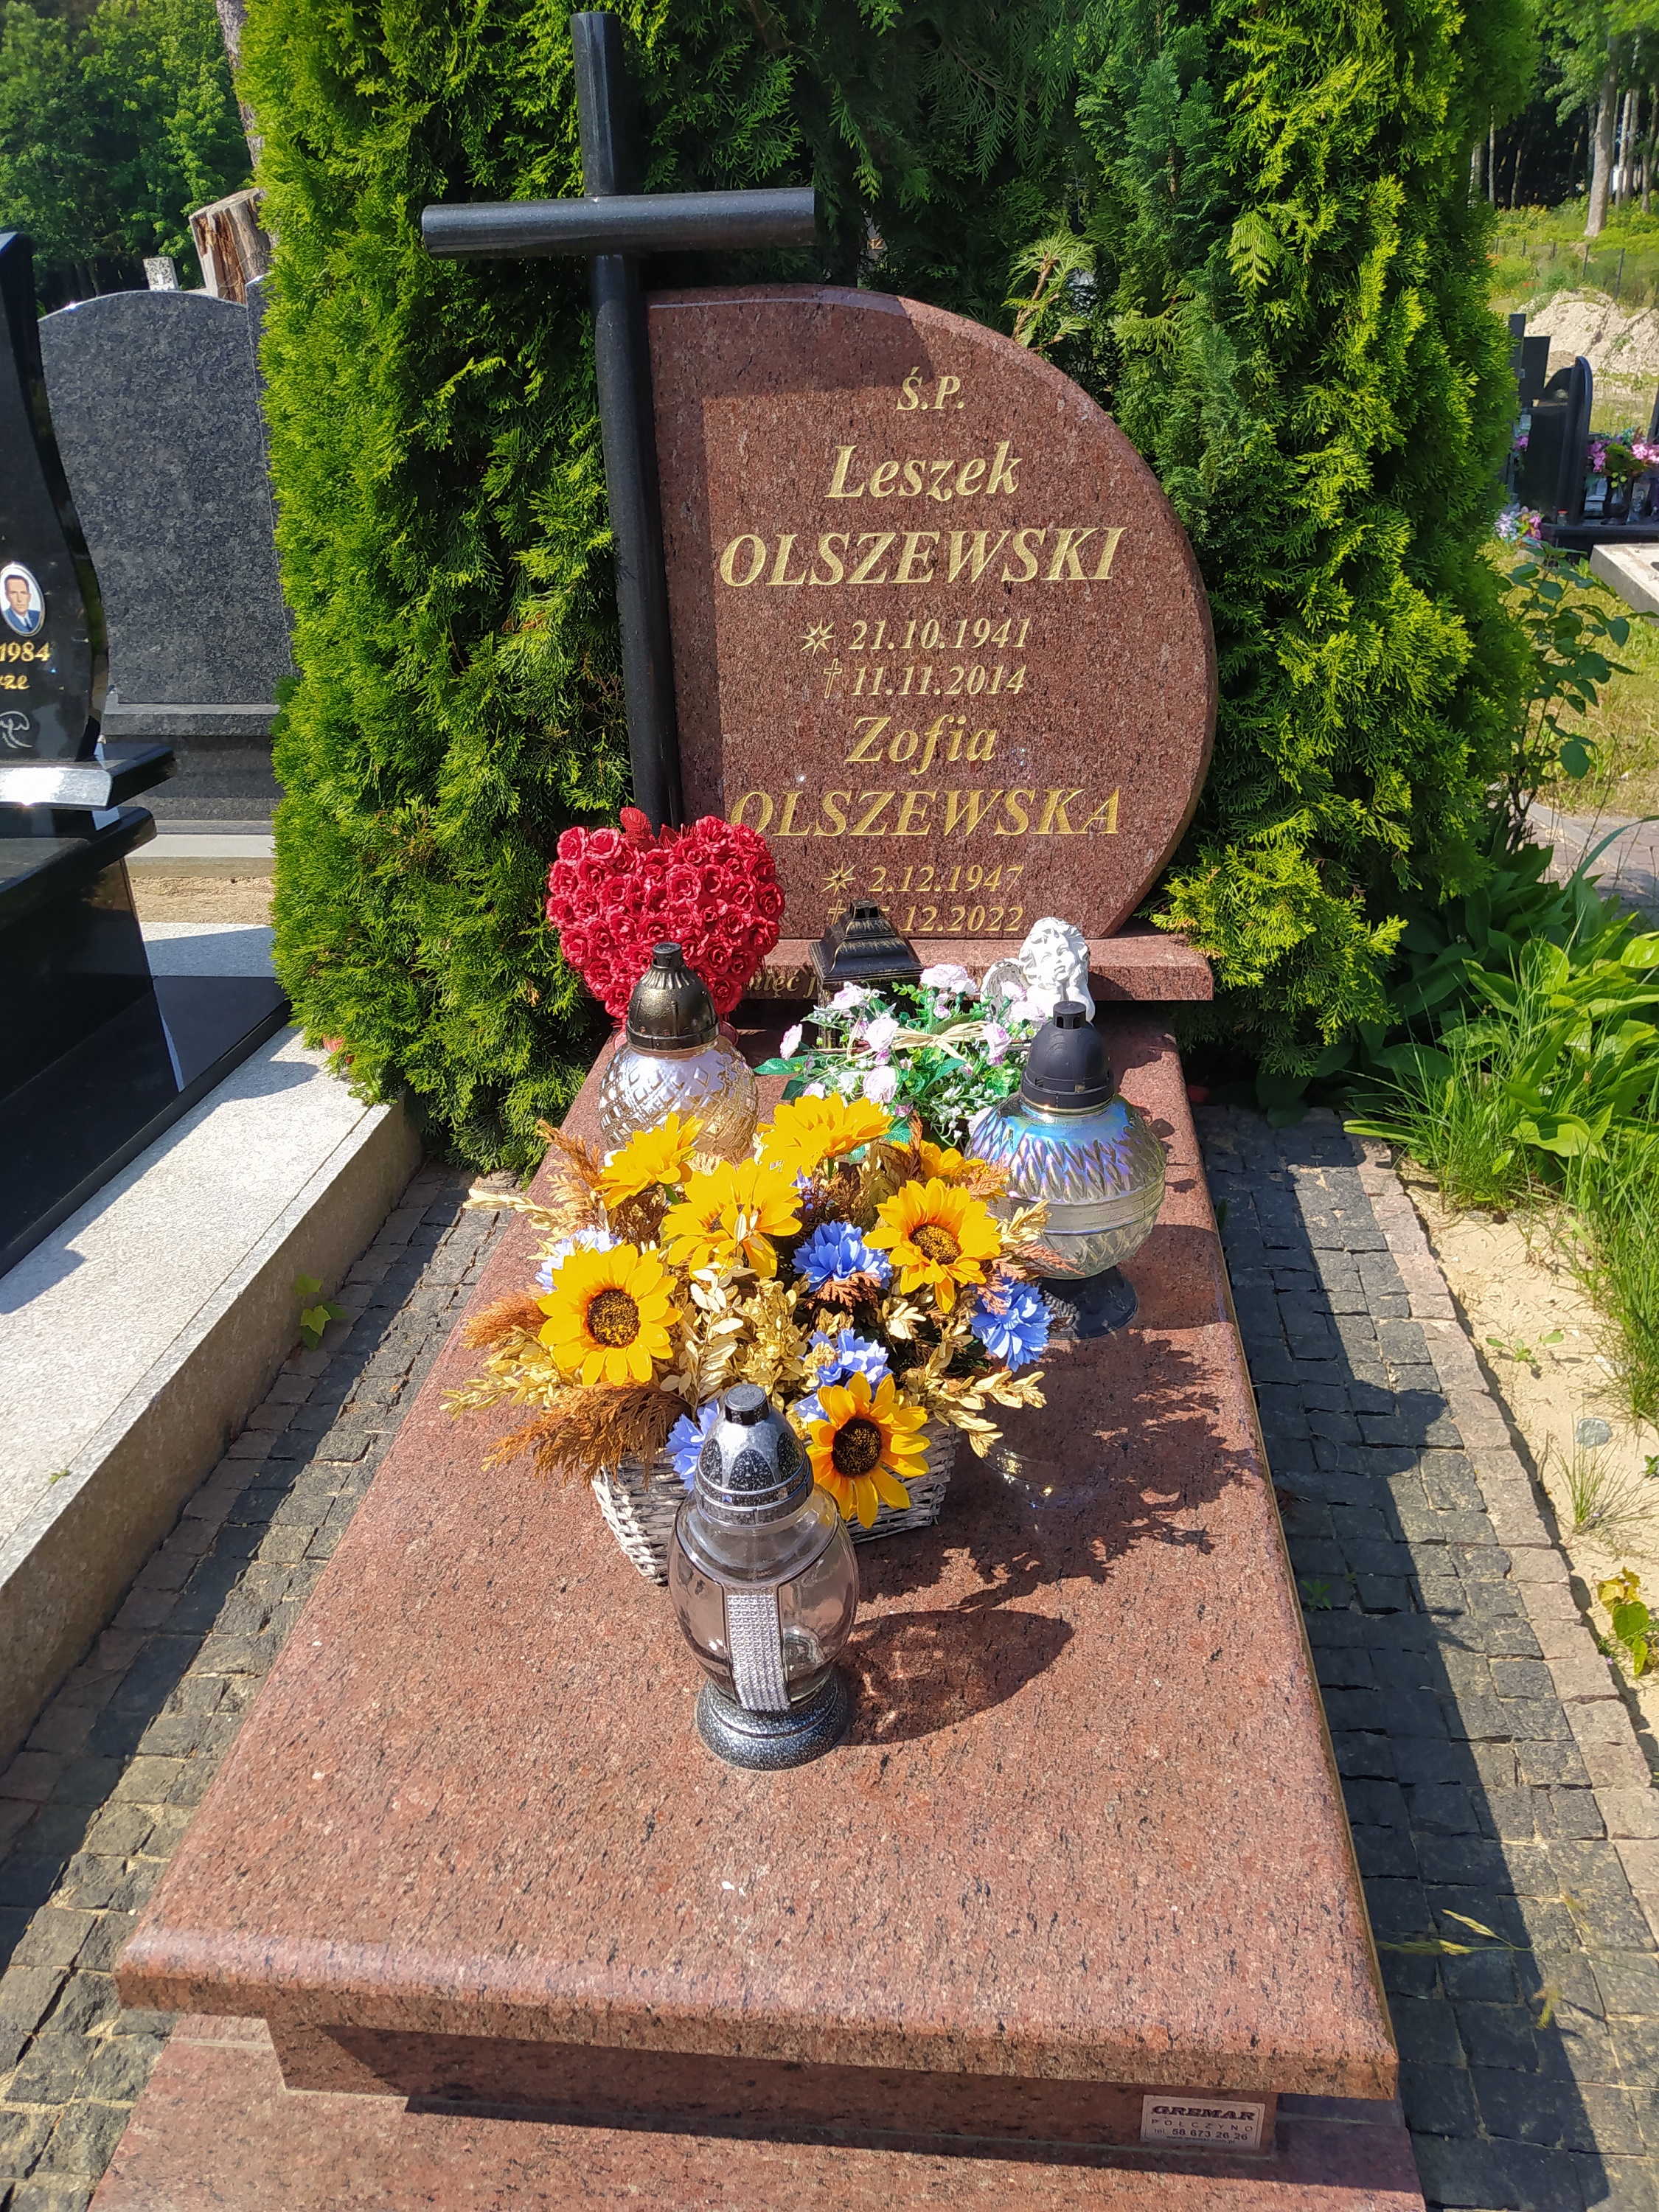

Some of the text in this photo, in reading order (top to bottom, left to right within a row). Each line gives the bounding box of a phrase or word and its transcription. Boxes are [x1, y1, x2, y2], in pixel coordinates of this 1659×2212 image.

[897, 366, 964, 411] Ś.P.
[824, 441, 1023, 501] Leszek
[719, 526, 1127, 587] OLSZEWSKI
[848, 617, 1031, 650] 21.10.1941
[850, 664, 1025, 696] 11.11.2014
[844, 713, 998, 775] Zofia
[730, 787, 1121, 837] OLSZEWSKA
[868, 864, 1024, 892] 2.12.1947
[1152, 2106, 1256, 2121] GREMAR
[1190, 2129, 1211, 2138] 673
